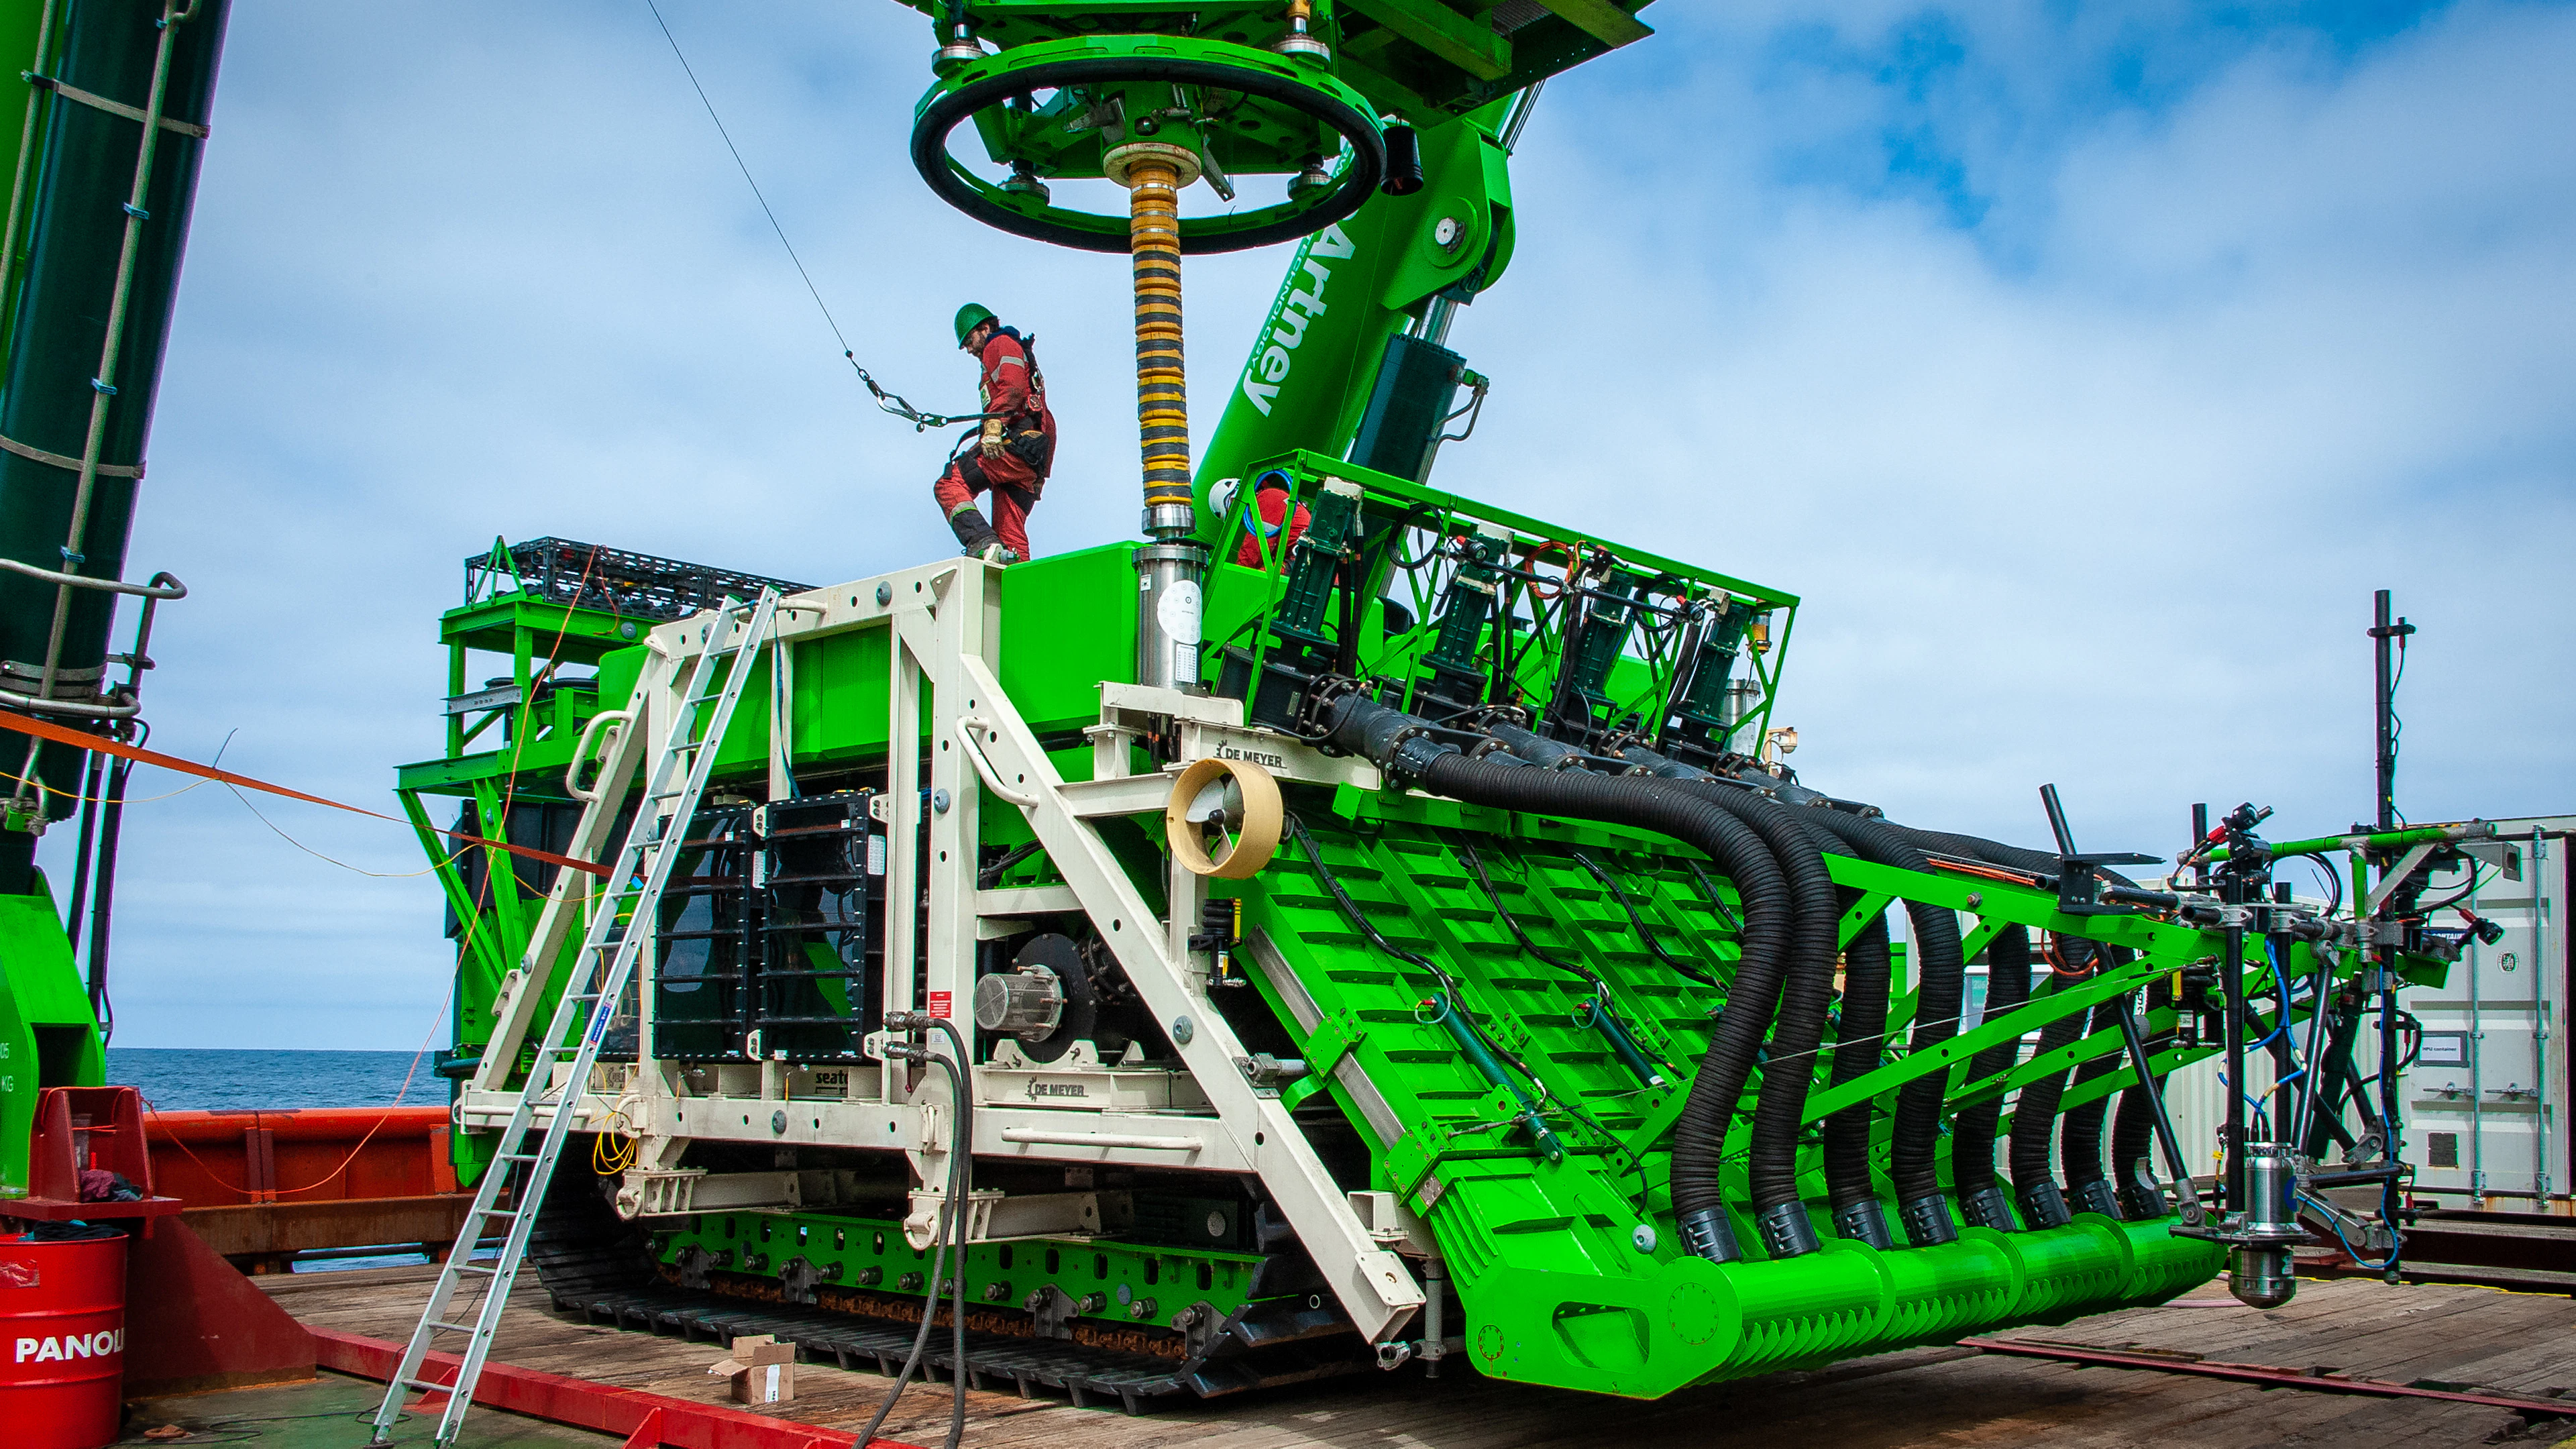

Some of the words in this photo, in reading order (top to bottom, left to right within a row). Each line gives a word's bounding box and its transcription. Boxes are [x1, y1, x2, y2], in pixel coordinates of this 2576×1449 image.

[1226, 748, 1240, 760] DE
[1244, 751, 1282, 767] MEYER
[1, 1075, 13, 1092] KG
[1035, 1083, 1047, 1095] DE
[1050, 1084, 1085, 1096] MEYER
